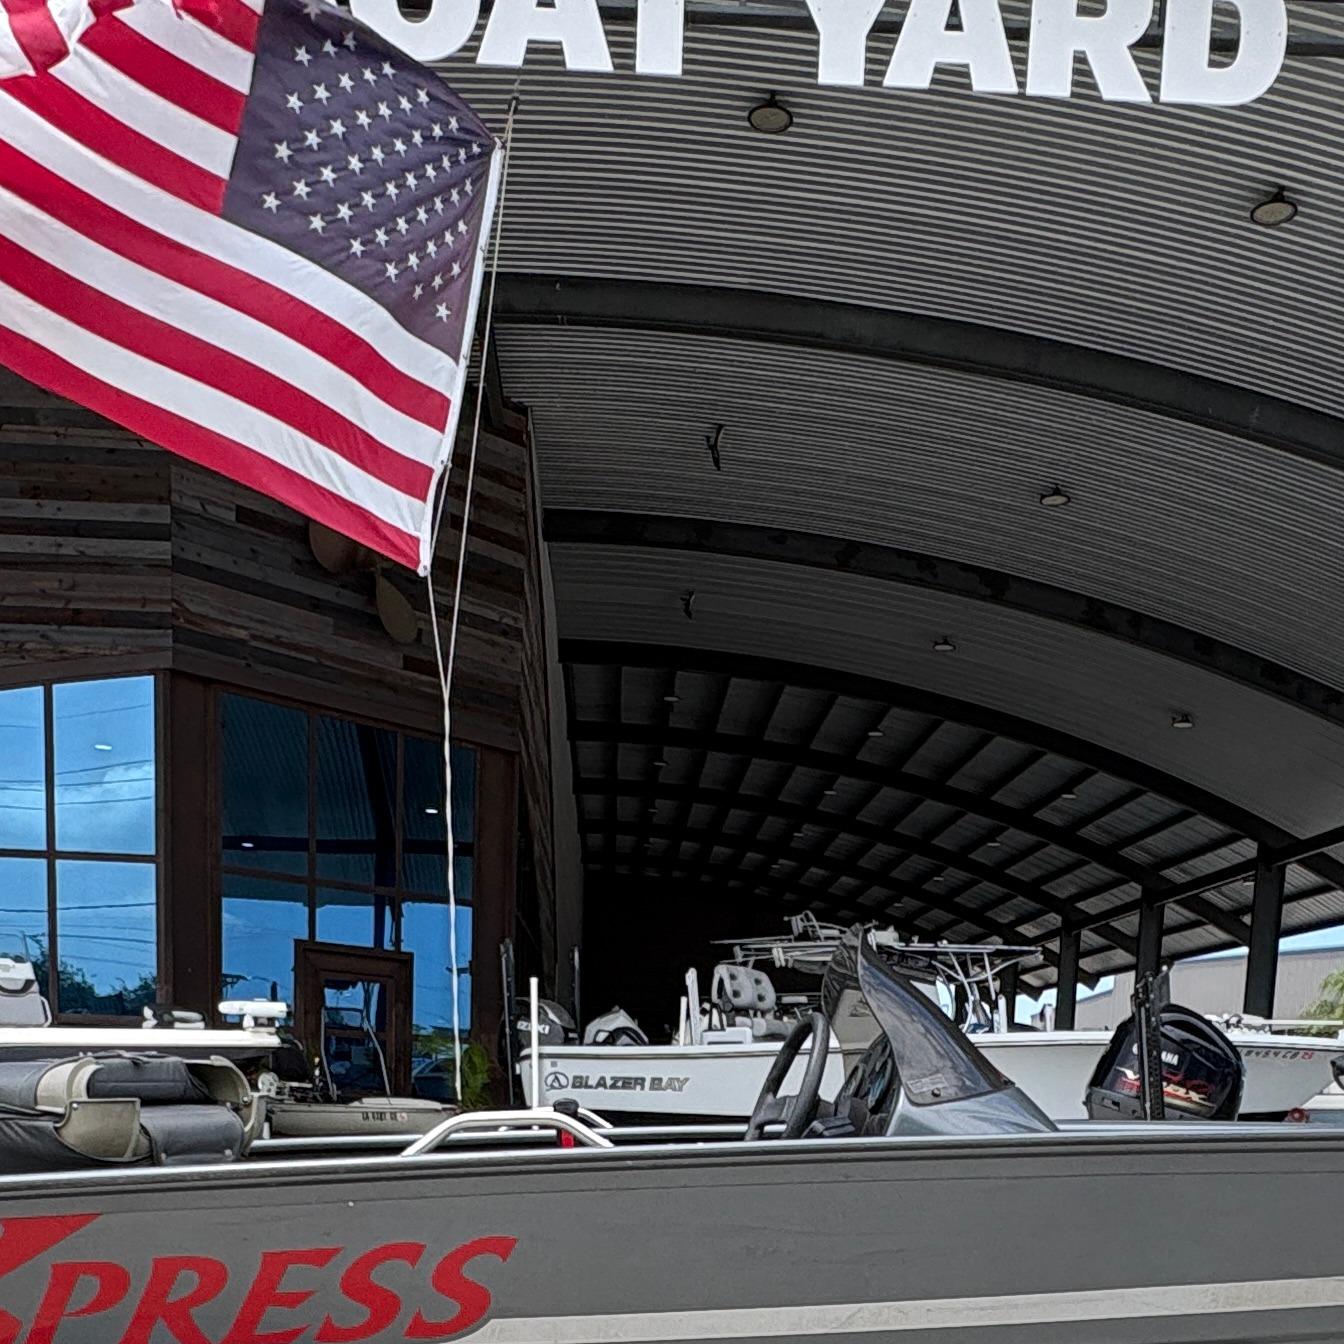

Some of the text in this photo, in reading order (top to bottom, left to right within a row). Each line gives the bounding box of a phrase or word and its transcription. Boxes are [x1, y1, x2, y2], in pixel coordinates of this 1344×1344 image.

[806, 0, 1288, 106] YARD
[571, 1075, 690, 1092] BLAZER BAY
